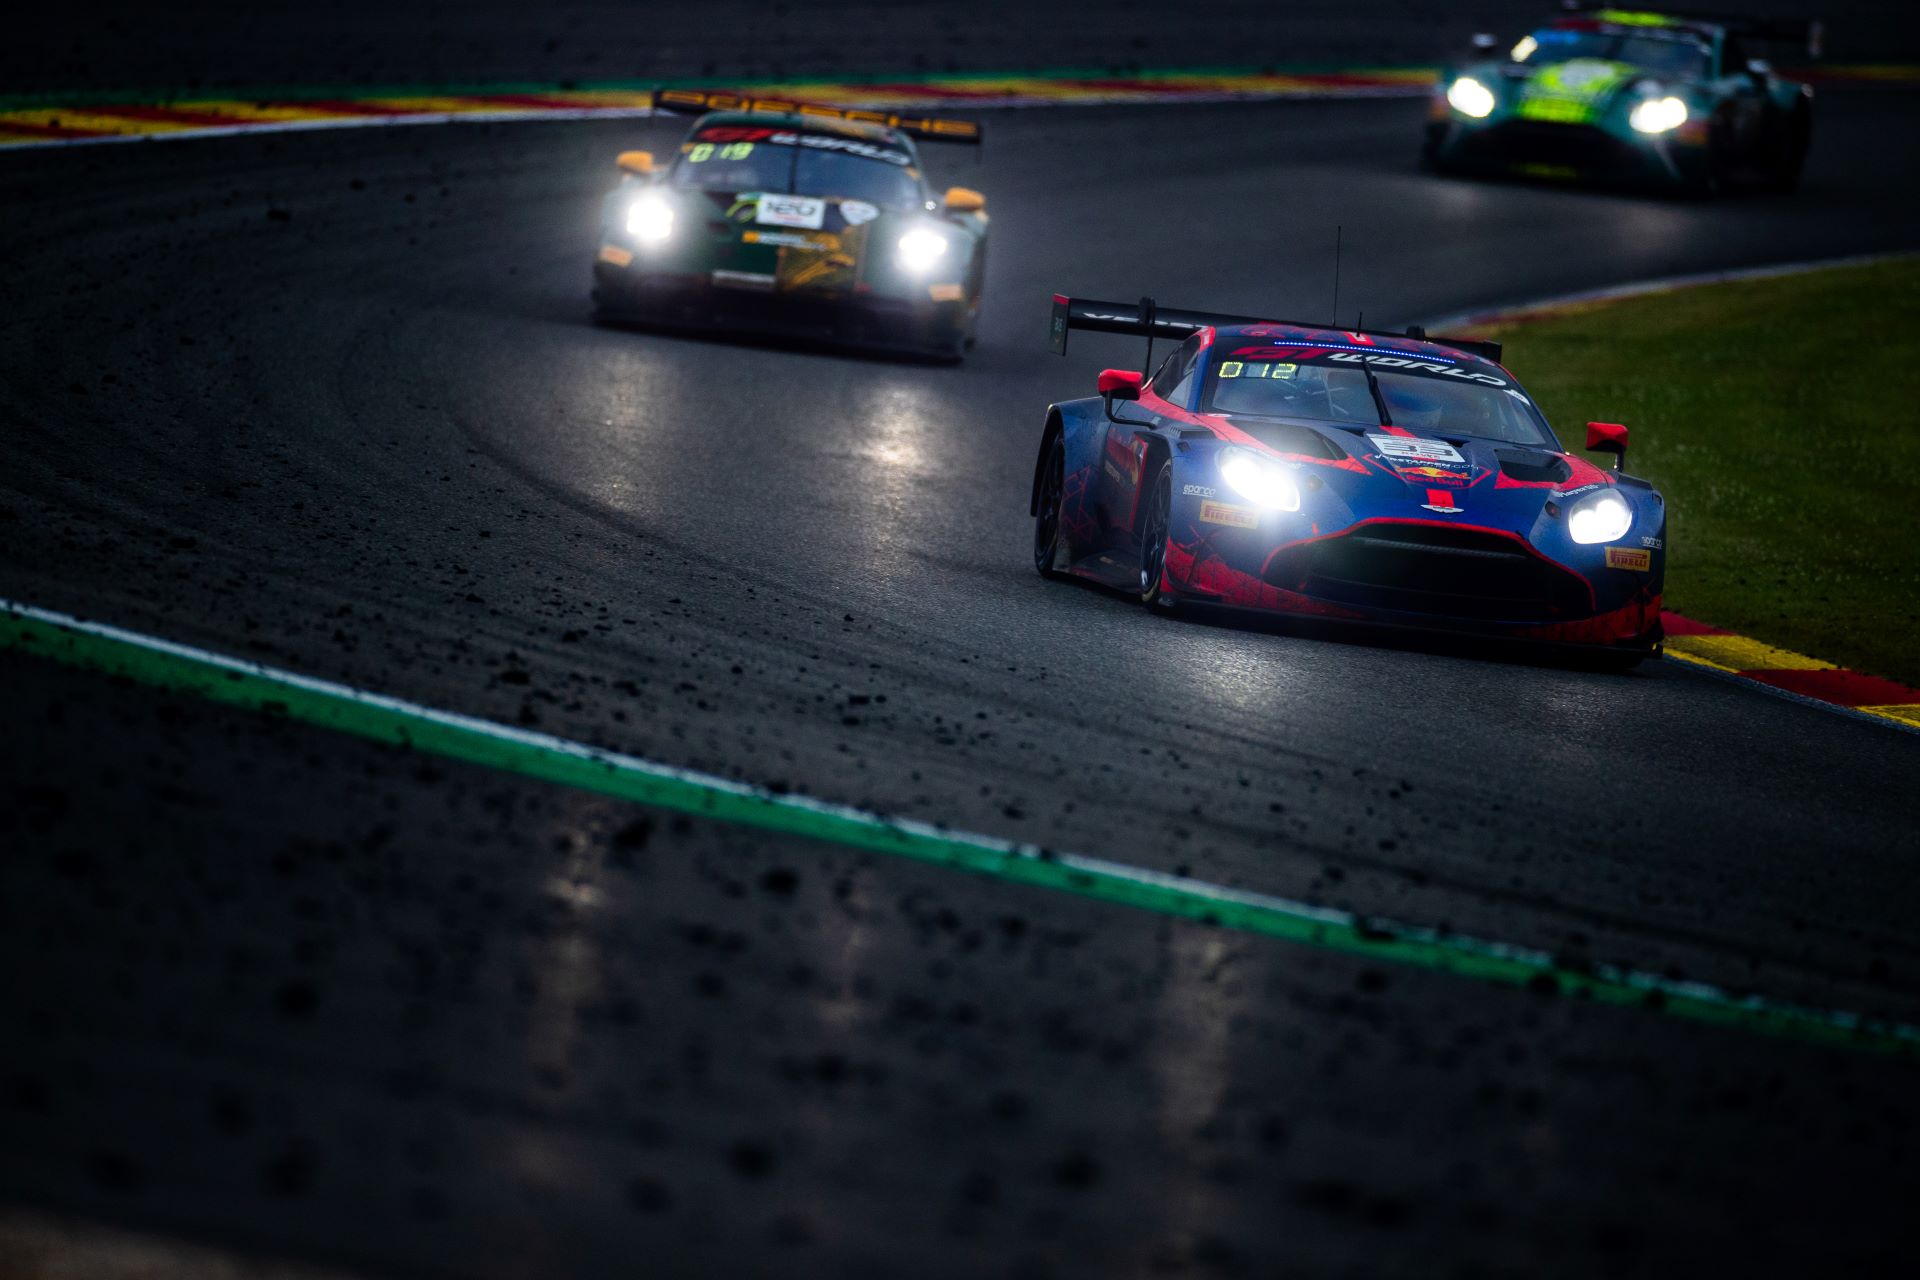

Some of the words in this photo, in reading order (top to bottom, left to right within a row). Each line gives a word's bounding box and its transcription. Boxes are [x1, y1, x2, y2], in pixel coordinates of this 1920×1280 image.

[1327, 352, 1507, 387] WORLD
[1382, 441, 1454, 457] 33
[1436, 476, 1464, 486] Bull
[1182, 483, 1216, 497] sparco
[1609, 549, 1649, 568] PIRELLI
